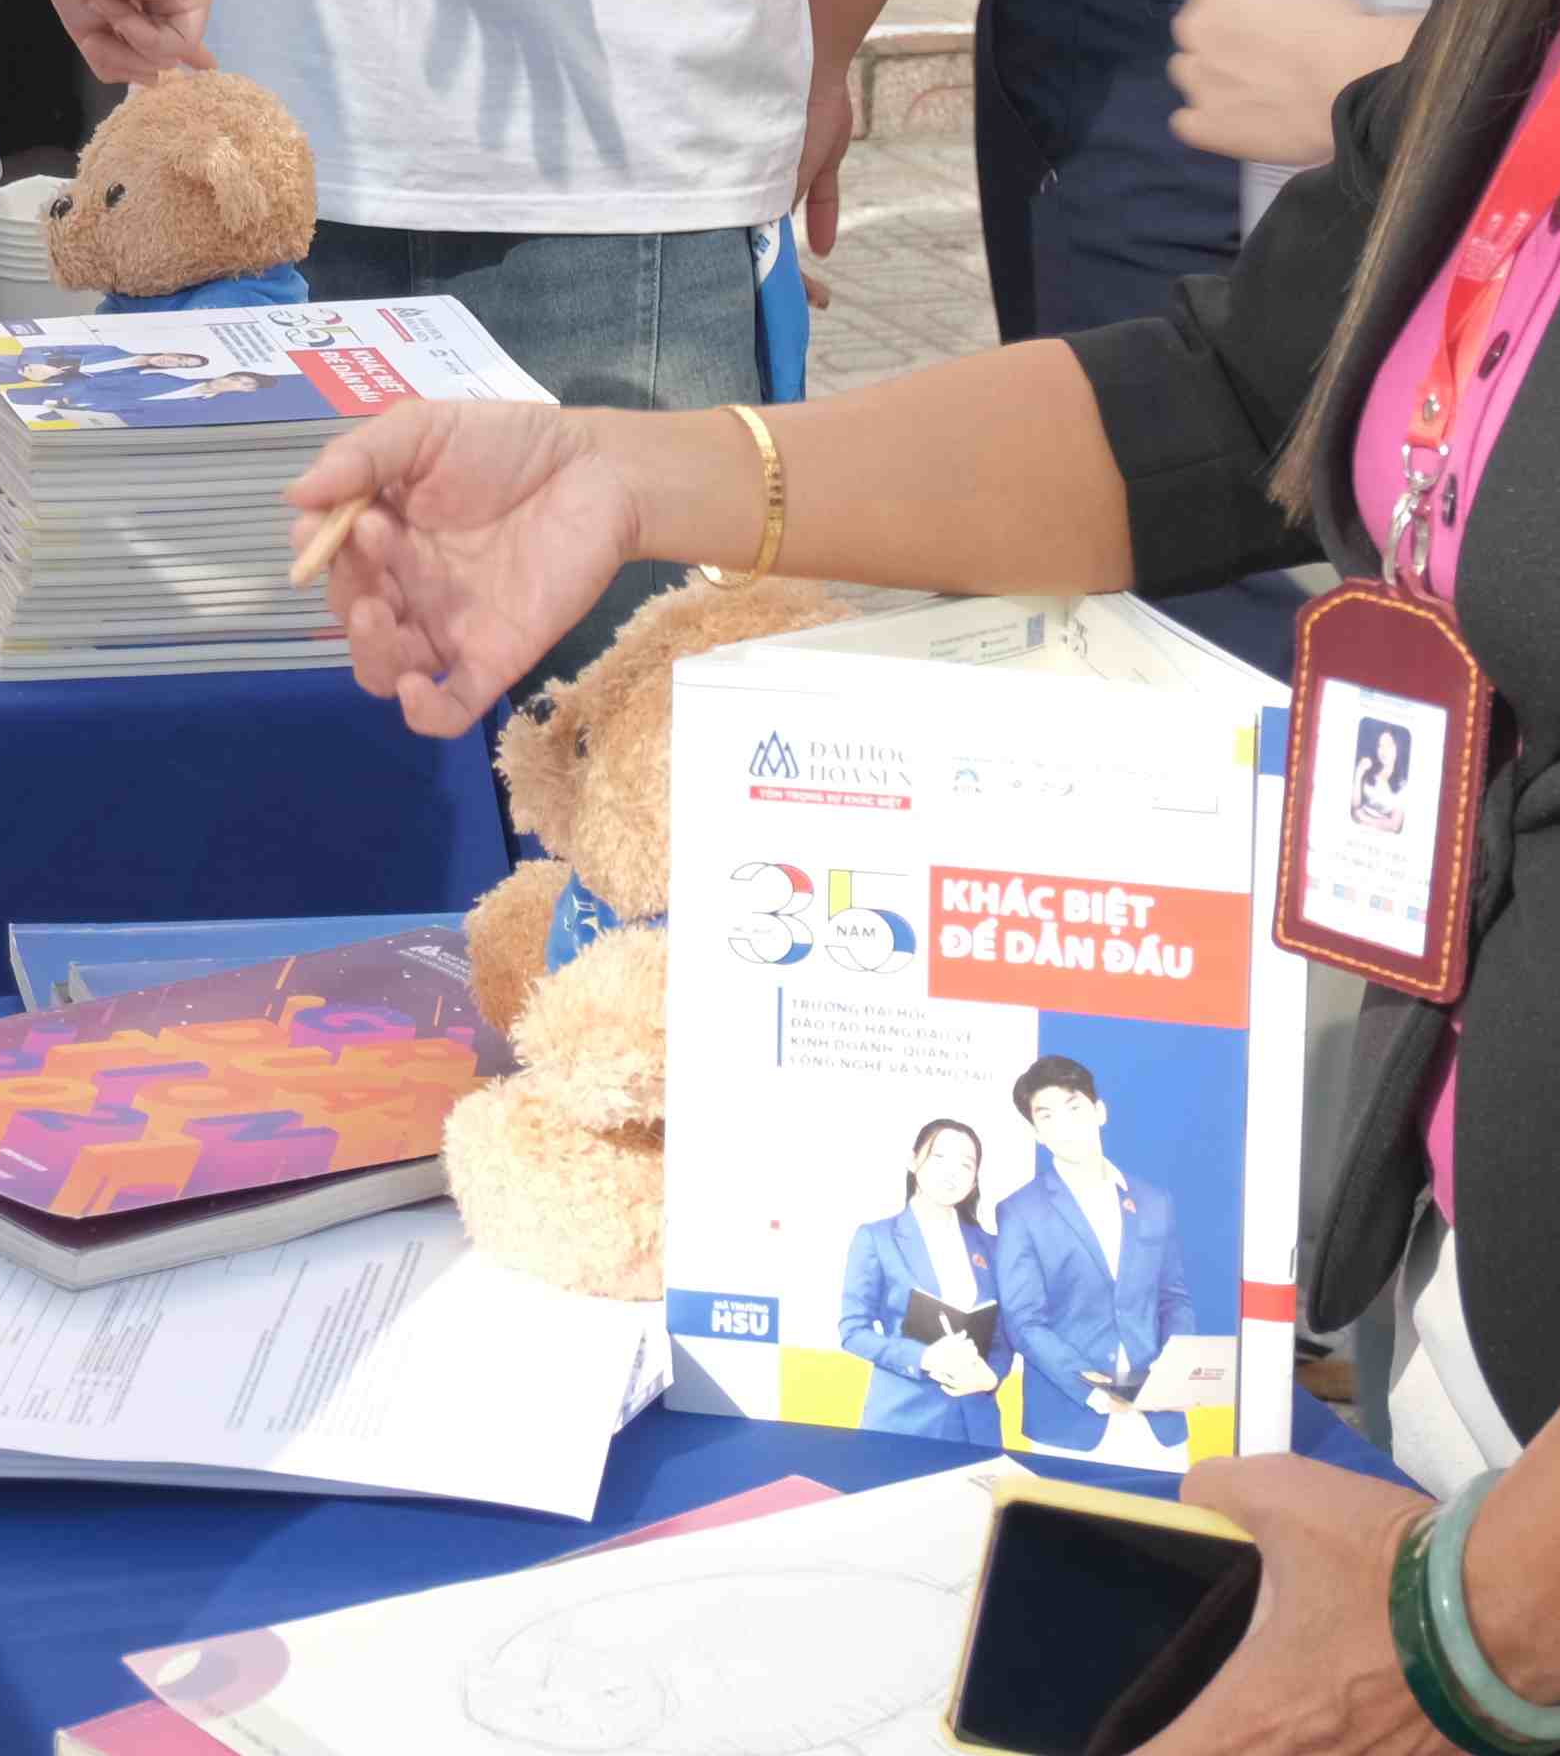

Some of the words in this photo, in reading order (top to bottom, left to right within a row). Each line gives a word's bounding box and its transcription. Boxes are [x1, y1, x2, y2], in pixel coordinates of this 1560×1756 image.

[940, 876, 1057, 921] KHÁC
[1061, 886, 1156, 936] BIỆT
[711, 1309, 770, 1337] HSU
